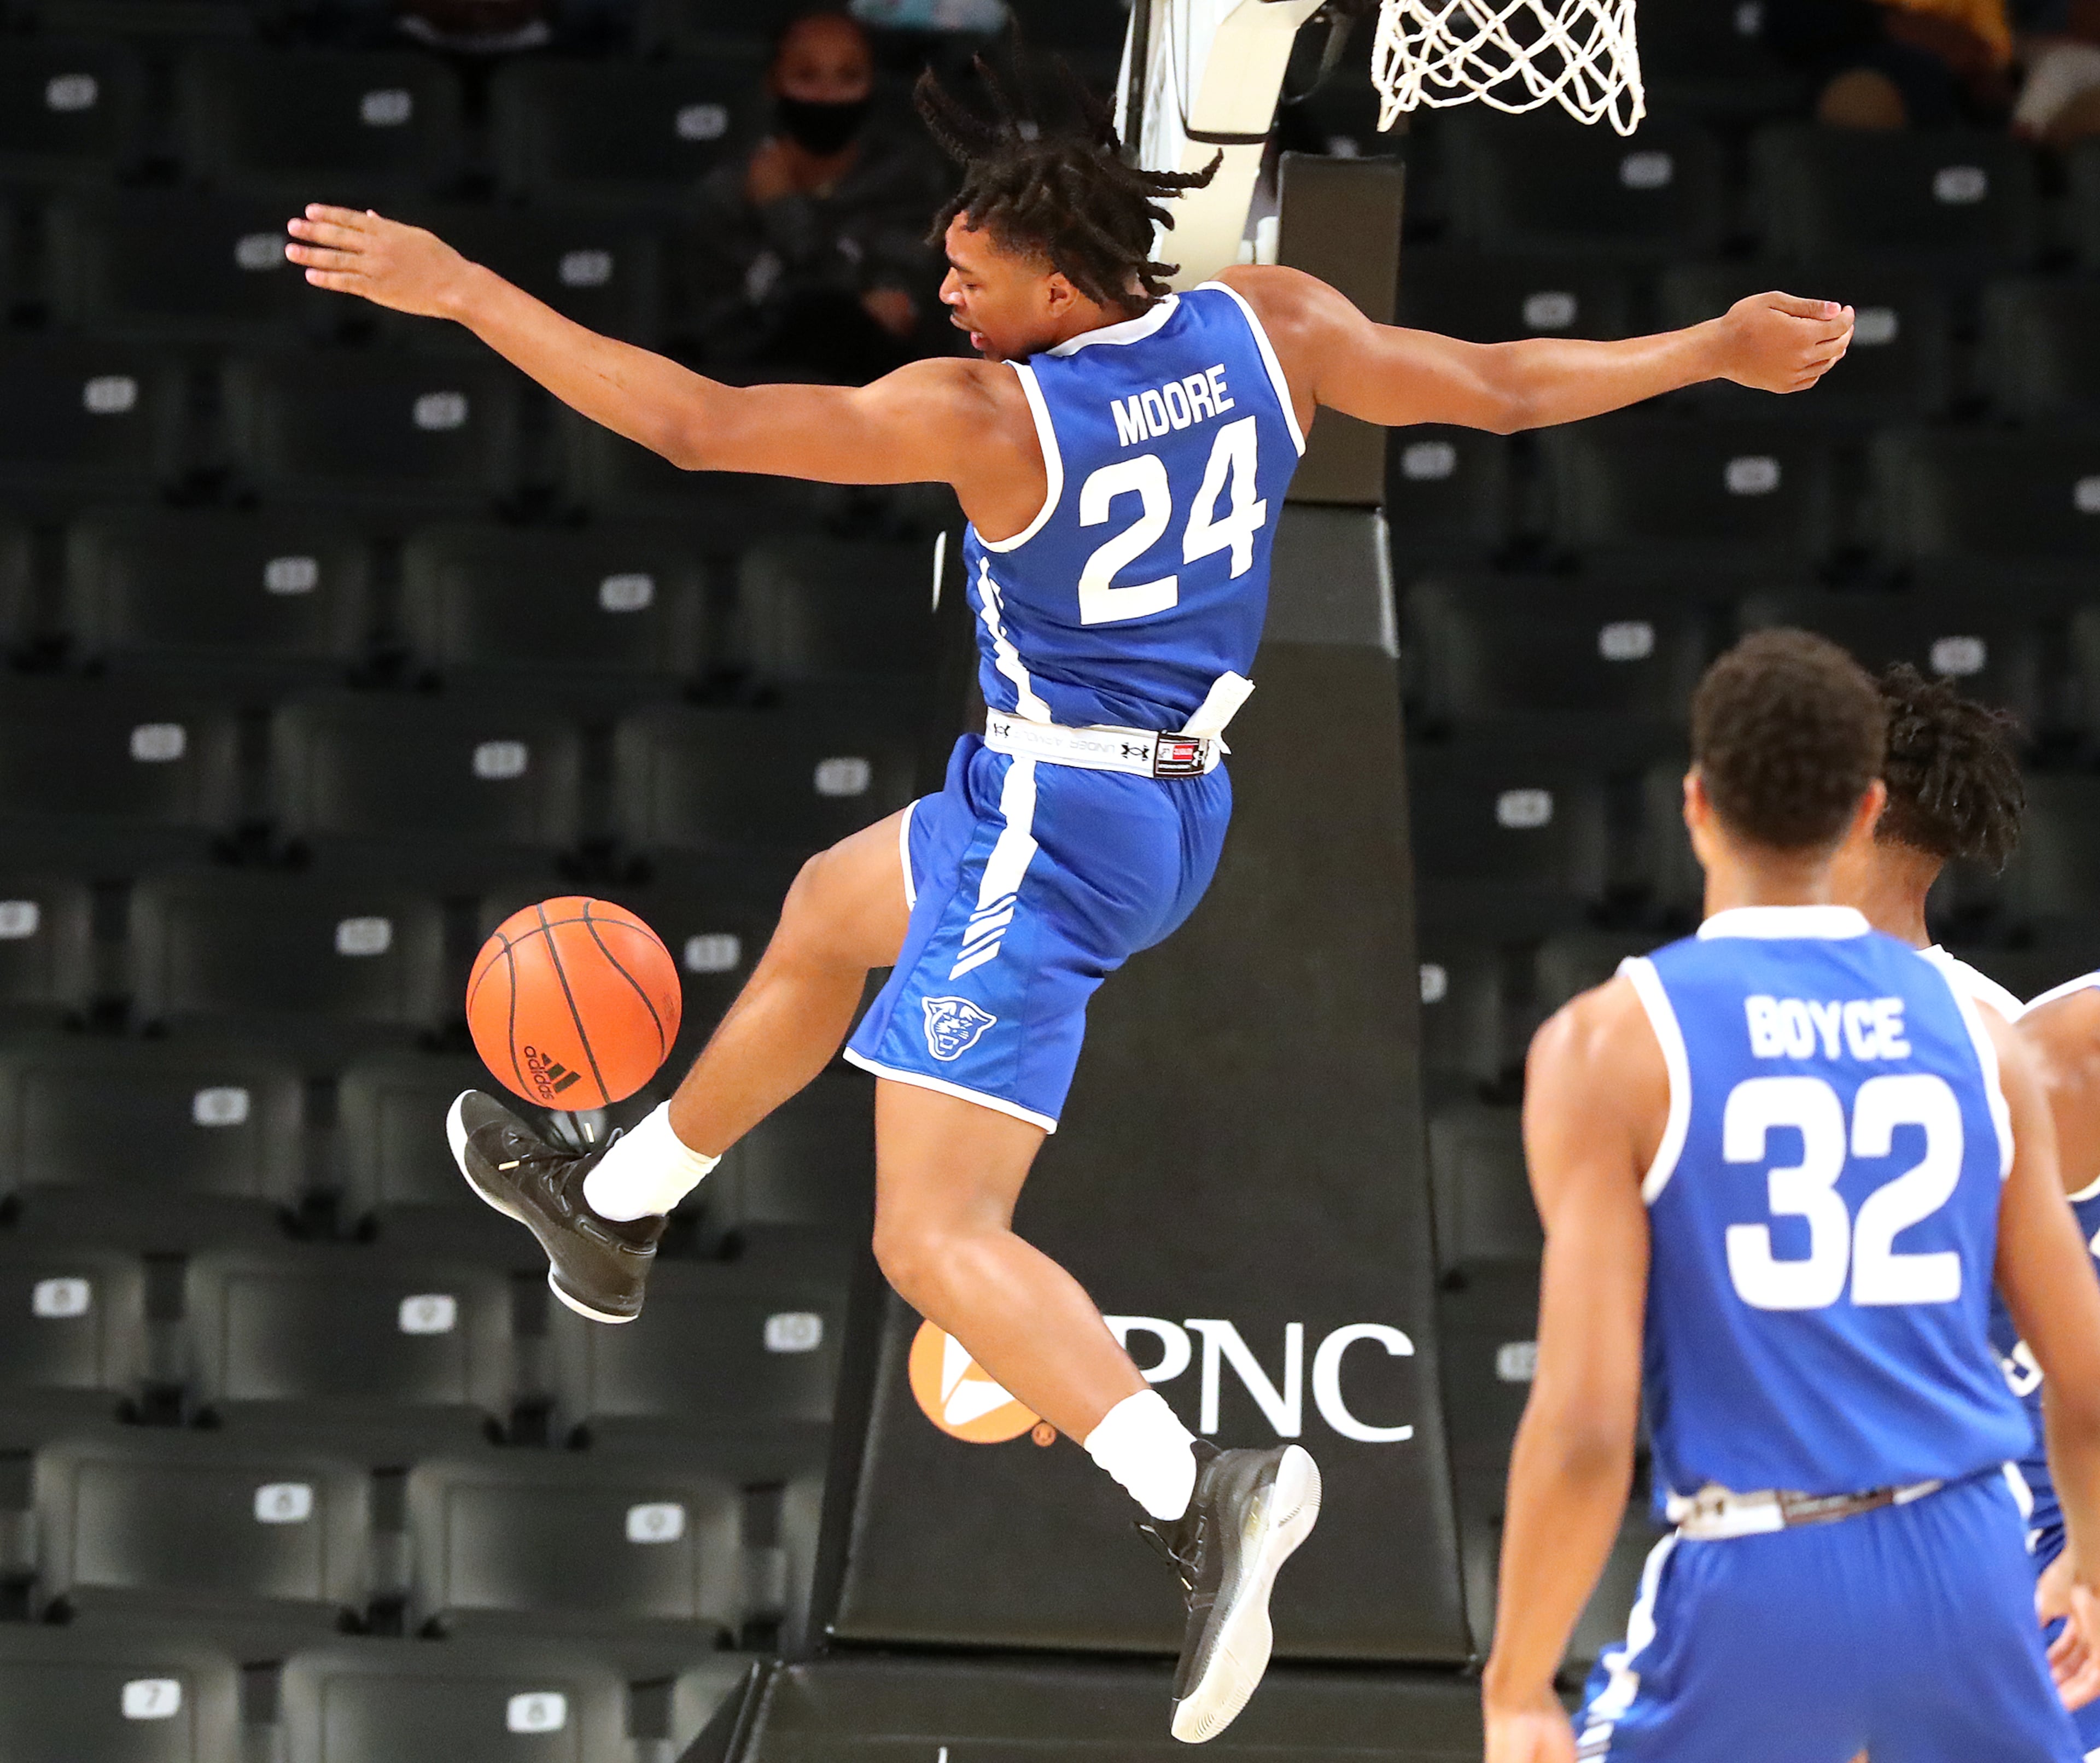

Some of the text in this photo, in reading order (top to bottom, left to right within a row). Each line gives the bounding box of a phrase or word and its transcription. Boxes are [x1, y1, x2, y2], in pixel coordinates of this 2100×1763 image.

[1110, 363, 1235, 447] MOORE
[1078, 415, 1267, 626] 24
[1069, 740, 1115, 754] UNDER
[1743, 994, 1912, 1060] BOYCE
[524, 1046, 555, 1100] adidas
[1722, 1073, 1965, 1311] 32
[1101, 1315, 1415, 1443] PNC
[145, 1682, 162, 1709] 7
